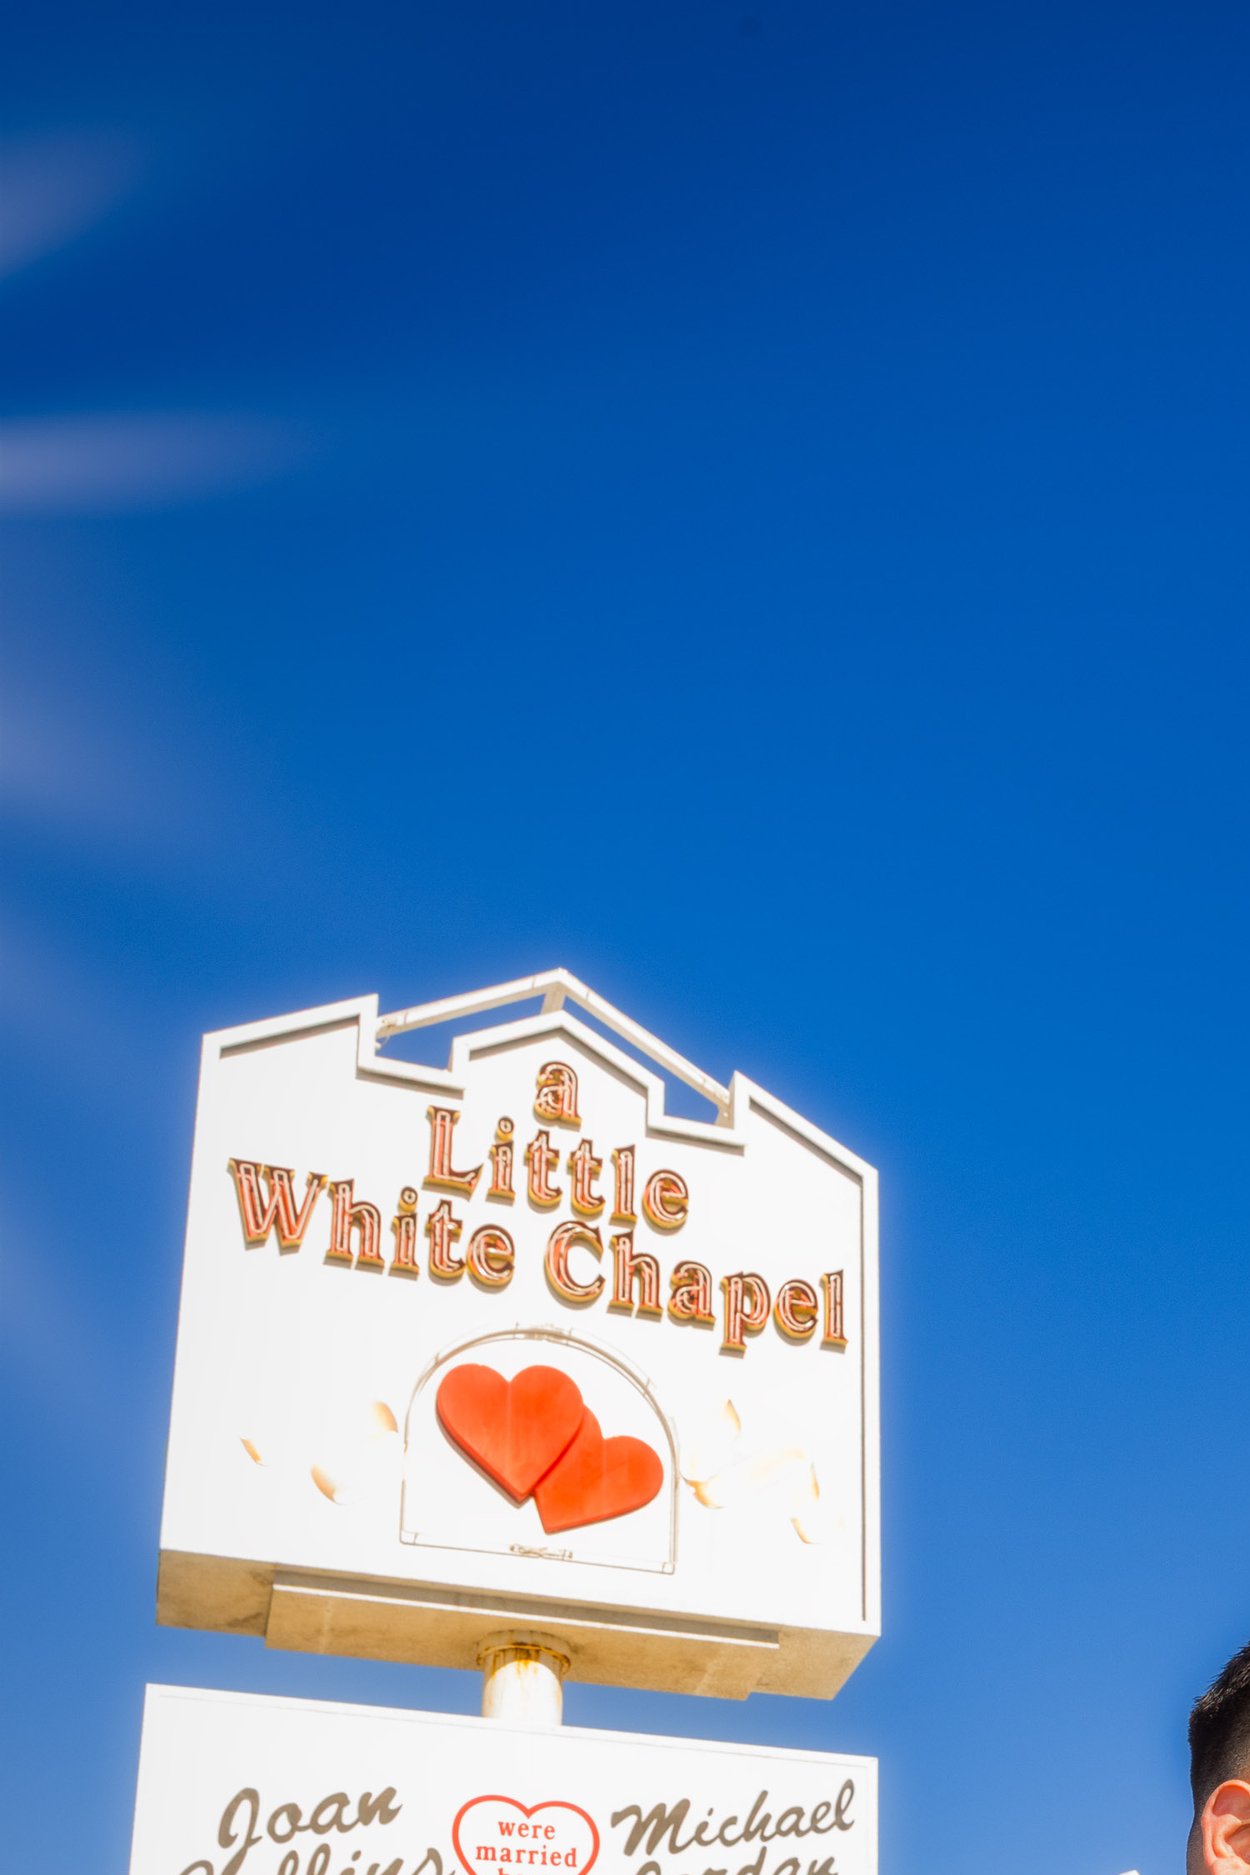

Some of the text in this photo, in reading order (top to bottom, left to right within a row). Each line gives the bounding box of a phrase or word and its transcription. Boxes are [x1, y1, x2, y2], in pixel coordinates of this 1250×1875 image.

[534, 1061, 581, 1126] a
[421, 1105, 689, 1236] Little
[227, 1158, 848, 1358] White Chapel
[497, 1821, 556, 1841] were
[610, 1778, 855, 1857] Michael
[475, 1846, 577, 1868] married
